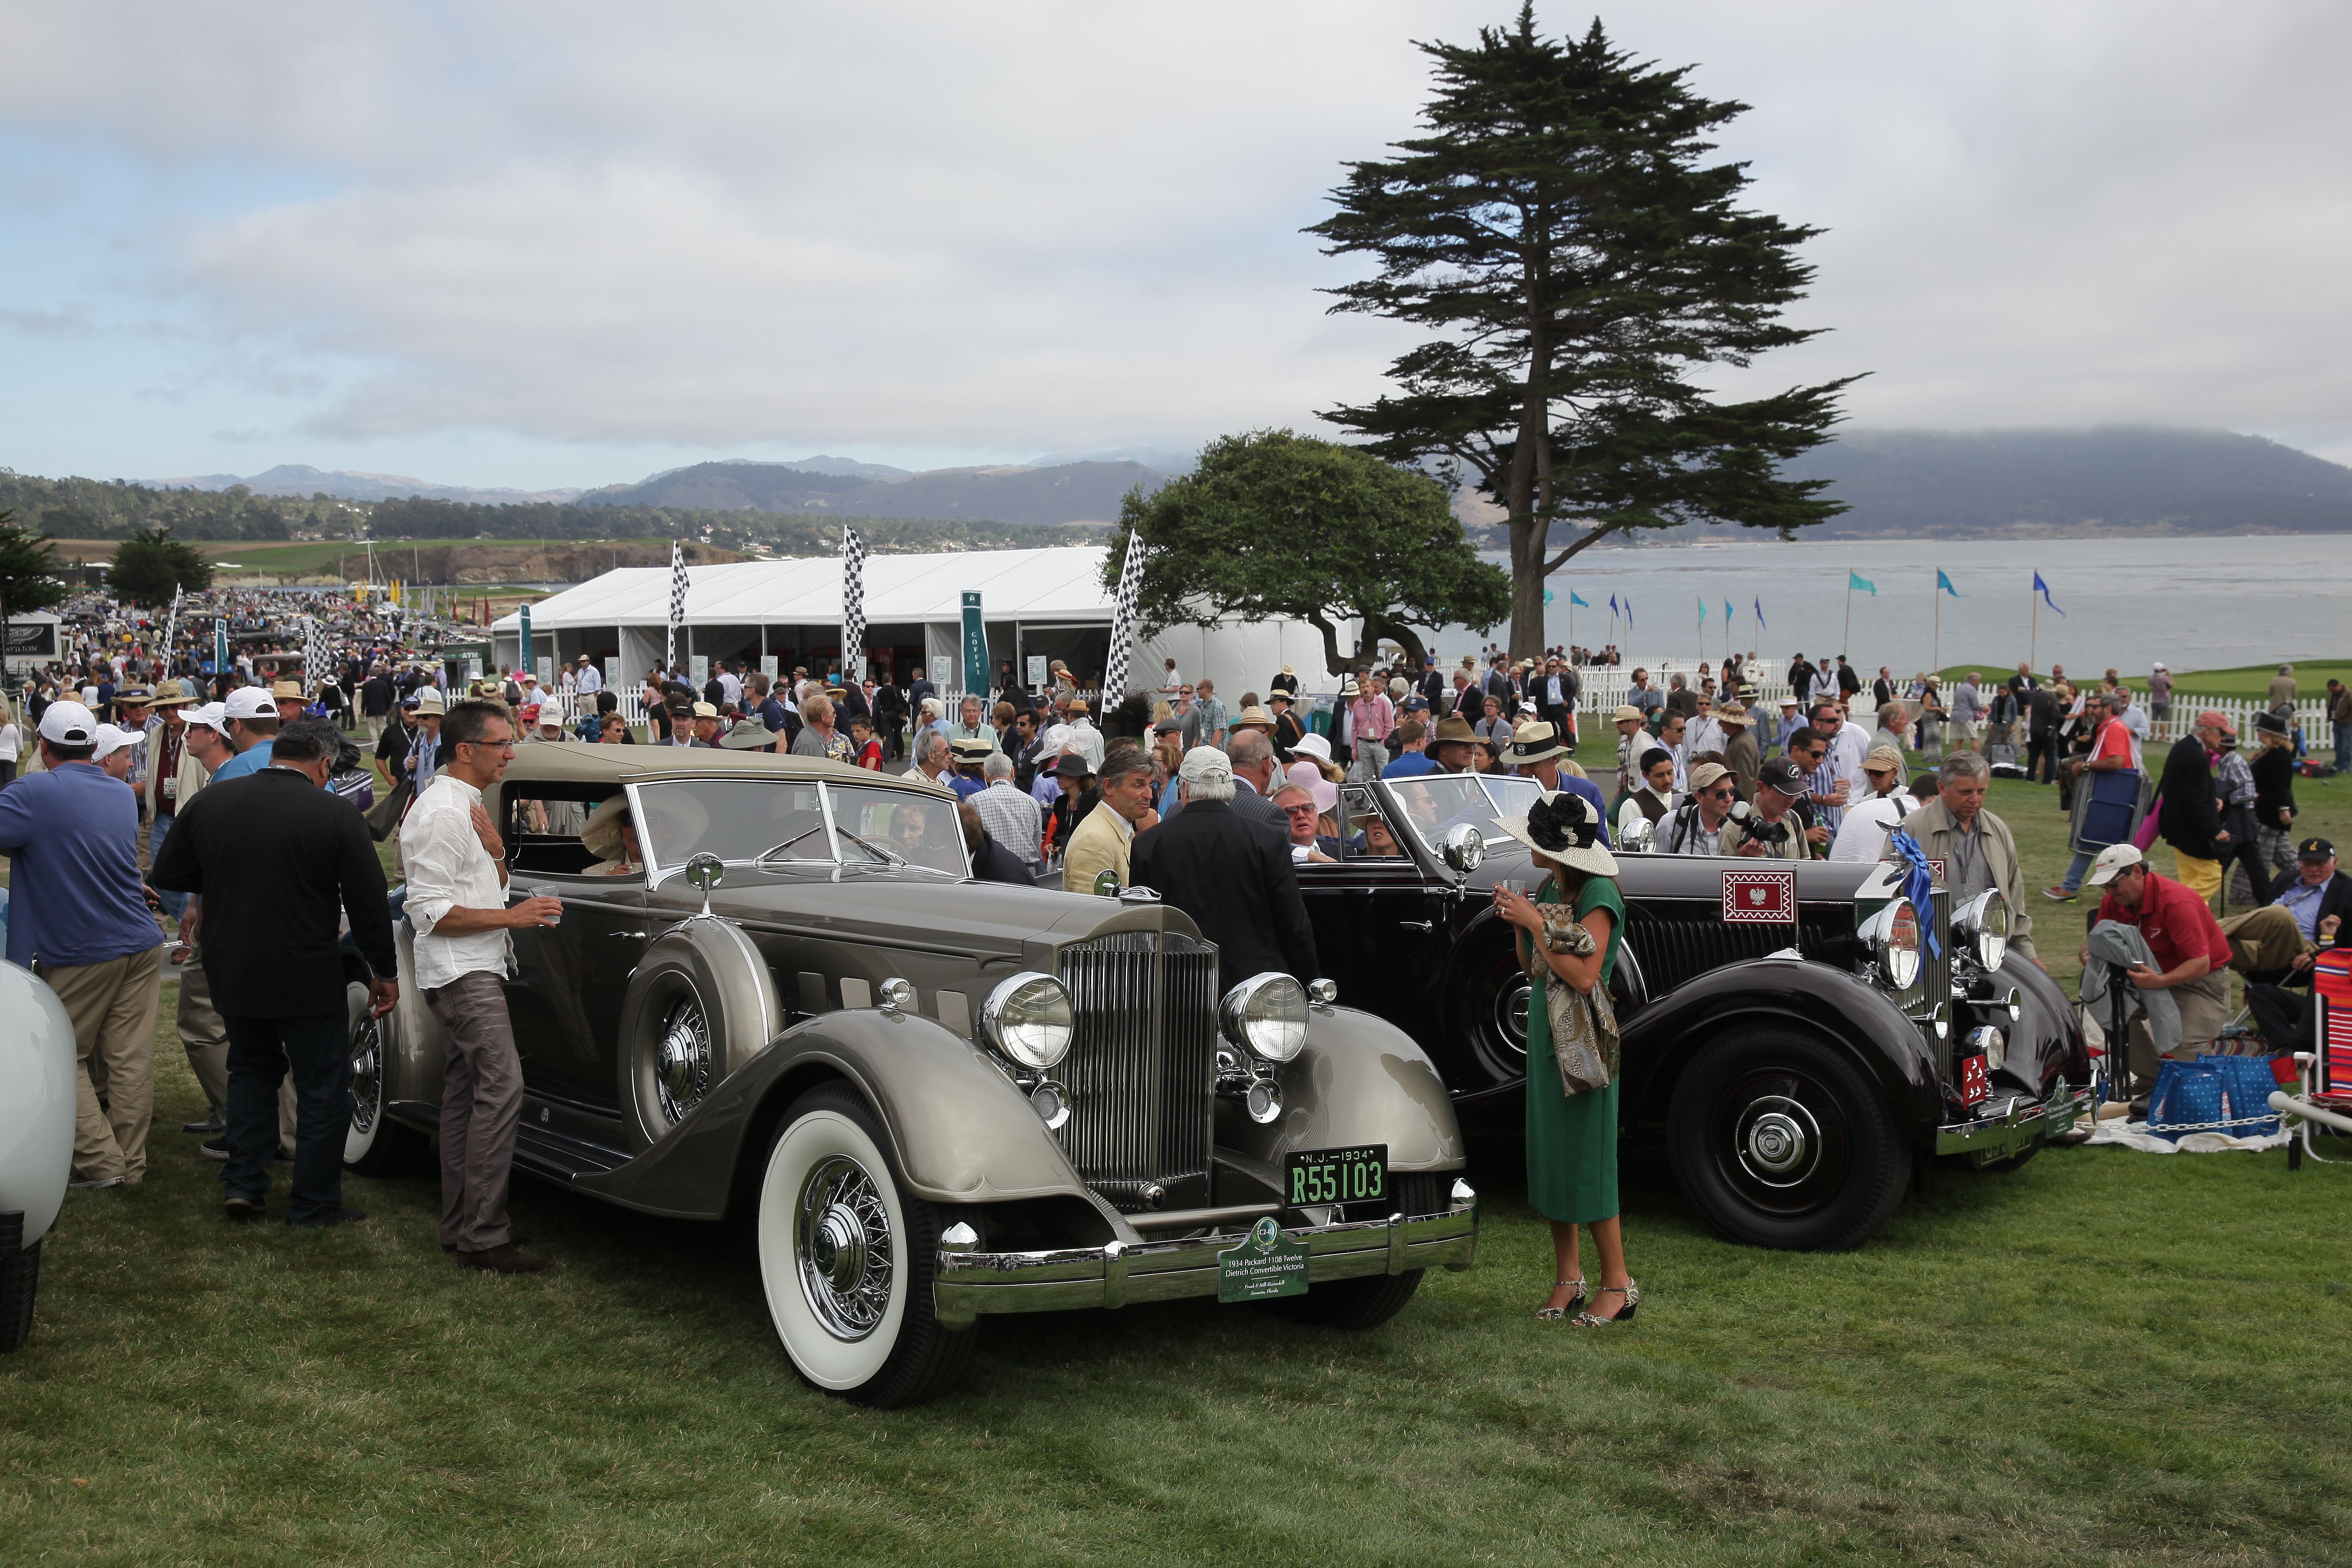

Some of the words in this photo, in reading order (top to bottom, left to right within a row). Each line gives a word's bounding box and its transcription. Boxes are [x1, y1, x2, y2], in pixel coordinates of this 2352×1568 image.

[972, 632, 980, 675] COFFEE
[1292, 1161, 1381, 1203] R55103
[1225, 1268, 1248, 1277] Dietrich
[1250, 1264, 1282, 1274] Convertible
[1283, 1262, 1304, 1271] Victoria
[1244, 1257, 1266, 1266] Packard
[1283, 1253, 1303, 1262] Twelve
